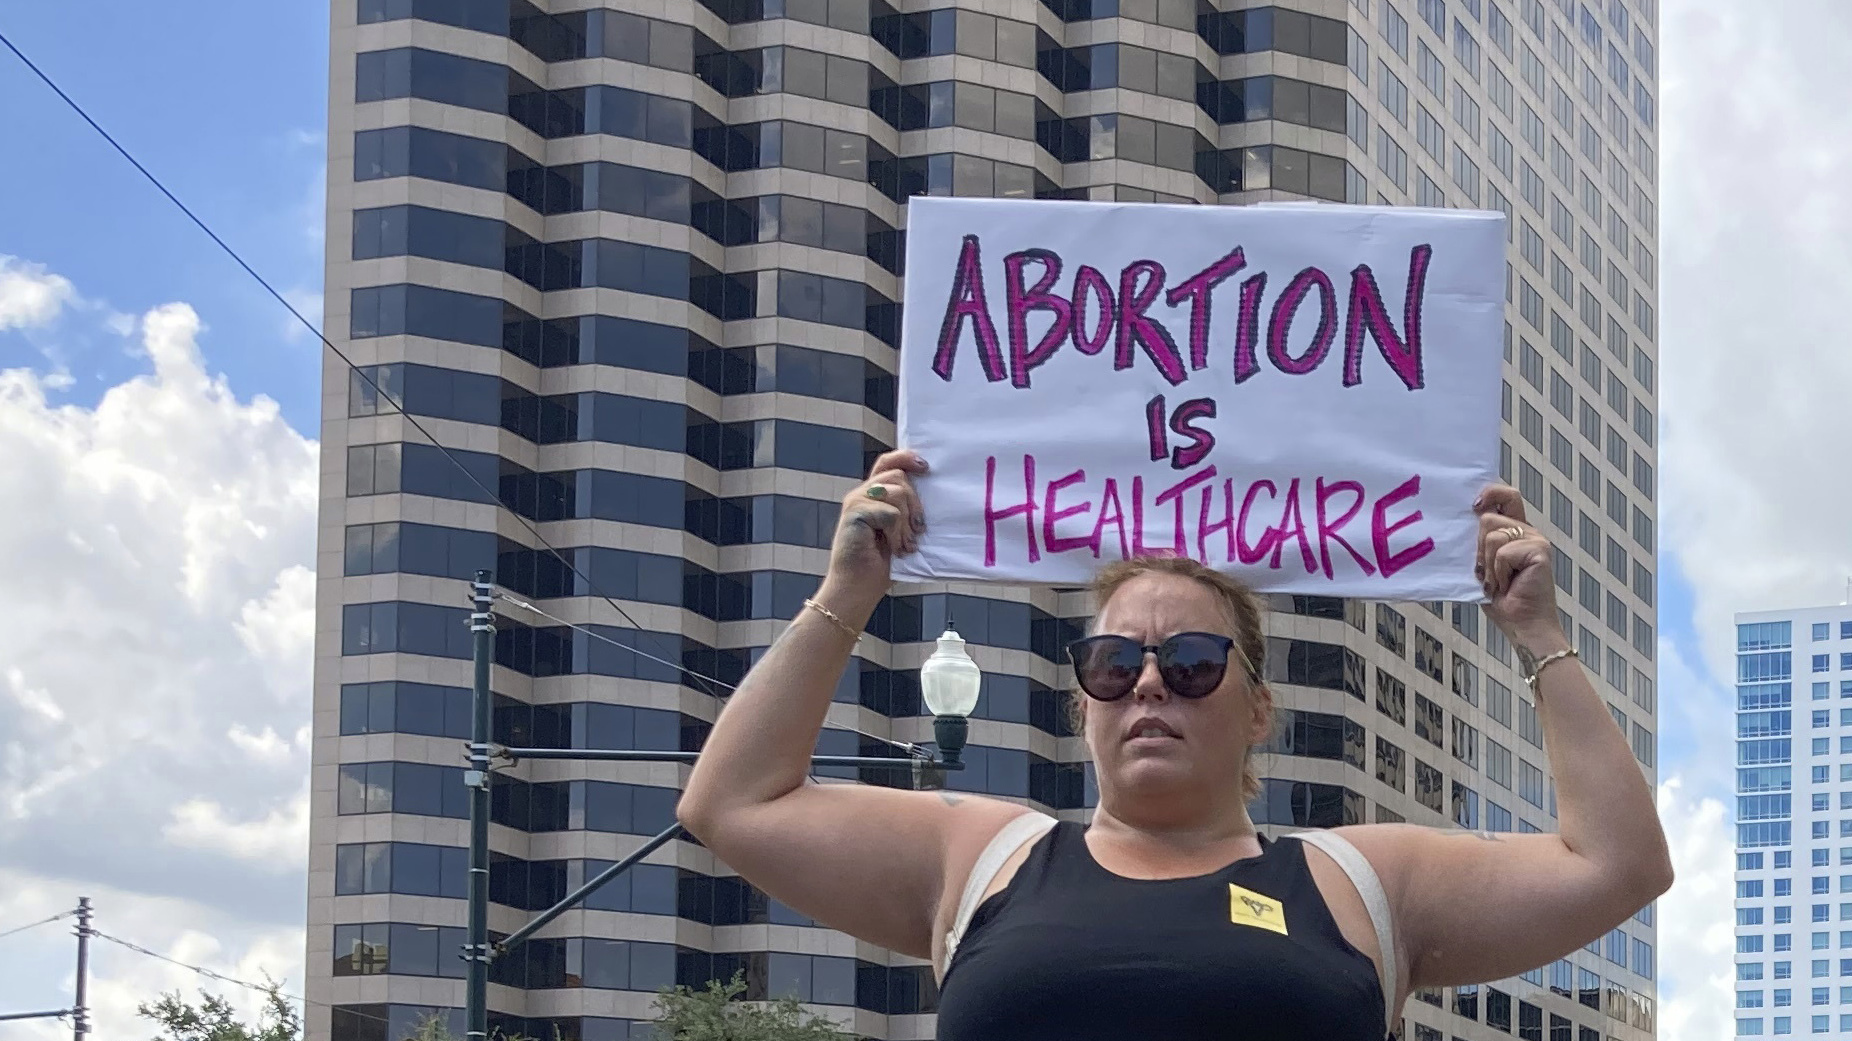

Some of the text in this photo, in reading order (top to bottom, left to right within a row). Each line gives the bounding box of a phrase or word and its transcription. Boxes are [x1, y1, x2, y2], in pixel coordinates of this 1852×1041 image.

[932, 233, 1432, 390] ABORTION
[1146, 394, 1217, 470] IS
[983, 454, 1435, 580] HEALTHCARE
